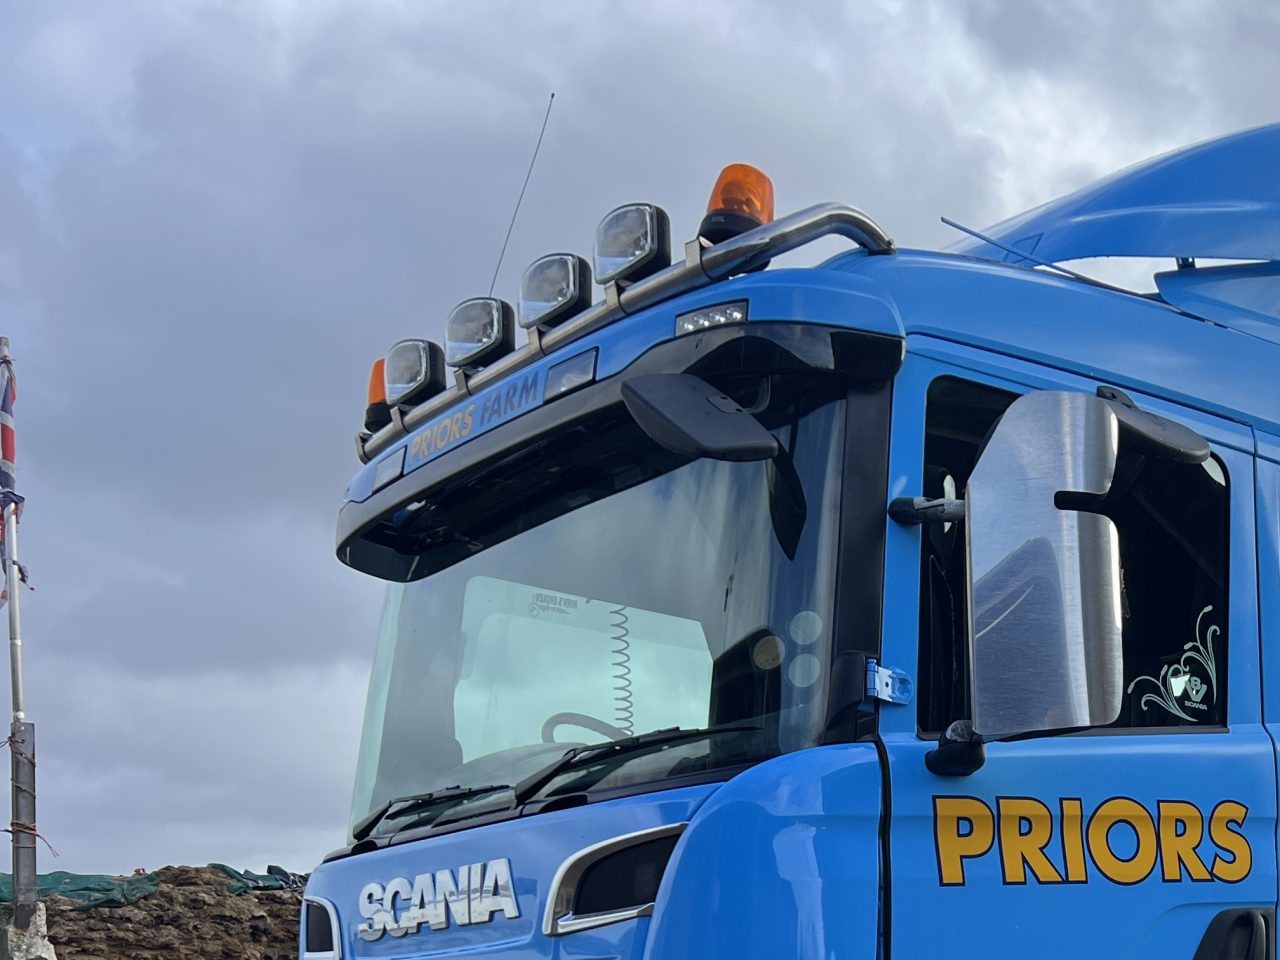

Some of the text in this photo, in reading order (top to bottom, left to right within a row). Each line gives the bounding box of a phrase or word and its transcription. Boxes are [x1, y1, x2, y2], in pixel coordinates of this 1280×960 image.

[409, 371, 539, 464] PRIORS FARM
[1184, 700, 1208, 711] SCANIA
[931, 795, 1252, 887] PRIORS
[358, 858, 519, 941] SCANIA
